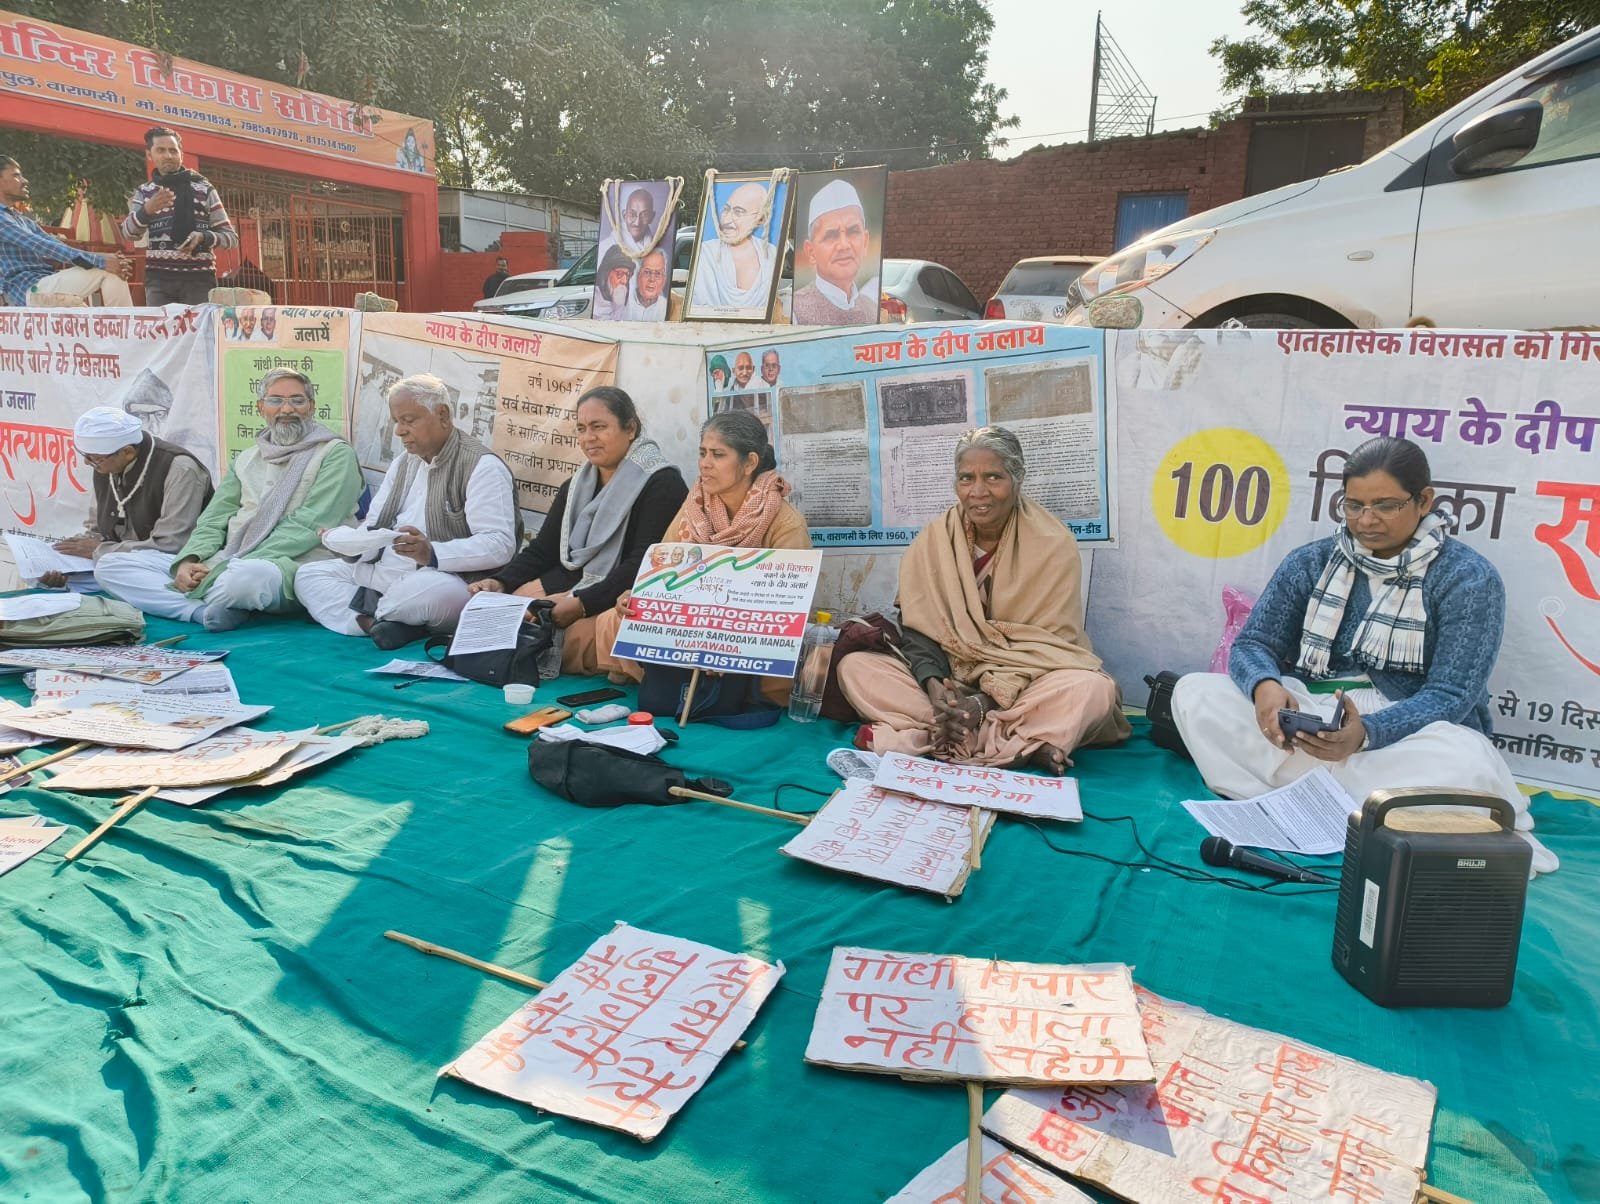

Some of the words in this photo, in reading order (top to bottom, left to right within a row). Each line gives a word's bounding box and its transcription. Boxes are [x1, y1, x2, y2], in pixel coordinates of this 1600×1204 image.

[23, 313, 48, 340] द्वारा
[51, 314, 90, 338] जबरन
[93, 314, 130, 339] कब्जा
[294, 322, 330, 342] जलायें
[426, 321, 456, 341] न्याय
[459, 321, 473, 343] के
[476, 324, 499, 349] दीप
[501, 333, 543, 356] जलायें
[853, 341, 902, 363] न्याय
[906, 333, 928, 359] के
[932, 330, 970, 359] दीप
[56, 342, 70, 375] के
[73, 343, 121, 378] खिलाफ
[253, 356, 272, 371] गांधी
[301, 356, 313, 371] की
[528, 372, 542, 390] वर्ष
[546, 379, 572, 393] 1964
[240, 401, 253, 417] सर्व
[319, 403, 331, 420] को
[502, 395, 519, 412] सर्व
[521, 396, 543, 416] सेवा
[506, 419, 517, 436] के
[518, 424, 549, 445] साहित्य
[1344, 404, 1450, 443] न्याय
[1459, 397, 1507, 445] के
[1515, 400, 1600, 454] दीप
[503, 449, 544, 469] तत्कालीन
[1170, 461, 1271, 526] 100
[858, 530, 867, 540] के
[868, 530, 883, 540] लिए
[653, 591, 683, 601] JAGAT
[636, 600, 683, 614] SAVE
[688, 604, 800, 624] DEMOCRACY
[641, 611, 687, 625] SAVE
[692, 616, 789, 634] INTEGRITY
[627, 623, 663, 635] ANDHRA
[666, 628, 704, 639] PRADESH
[706, 631, 758, 645] SARVODAYA
[674, 639, 742, 654] VIJAYAWADA.
[635, 646, 700, 663] NELLORE
[703, 654, 774, 671] DISTRICT
[1498, 690, 1520, 717] से
[1527, 701, 1553, 722] 19
[1457, 859, 1486, 868] AHUJA
[836, 992, 933, 1029] पर
[956, 1001, 1129, 1044] हमला
